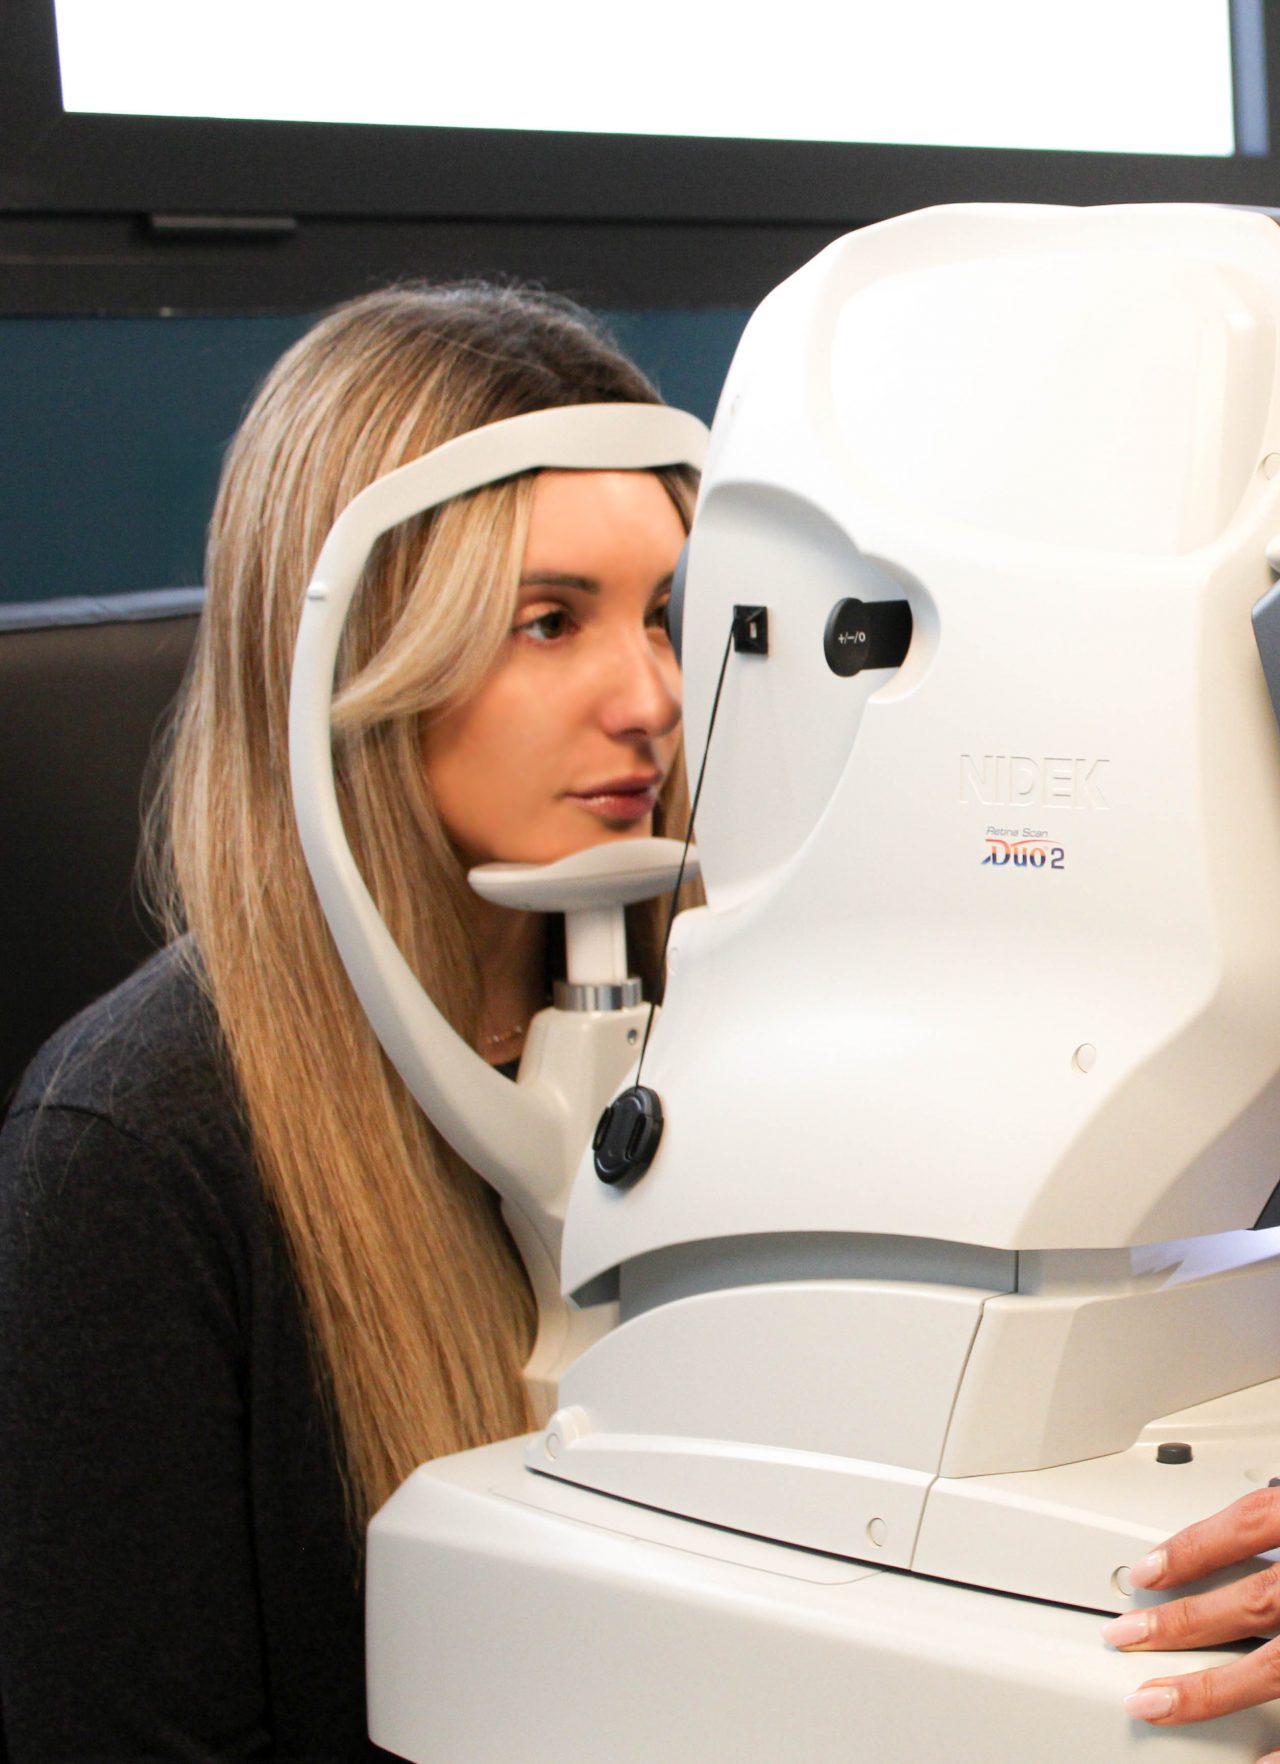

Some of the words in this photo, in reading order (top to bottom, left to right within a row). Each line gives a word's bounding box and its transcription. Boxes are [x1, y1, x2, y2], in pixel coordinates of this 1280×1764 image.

[959, 754, 1110, 809] NIDEK
[986, 826, 1019, 837] Retina
[1022, 827, 1049, 838] Scan
[981, 838, 1047, 868] Duo
[1050, 847, 1065, 869] 2
